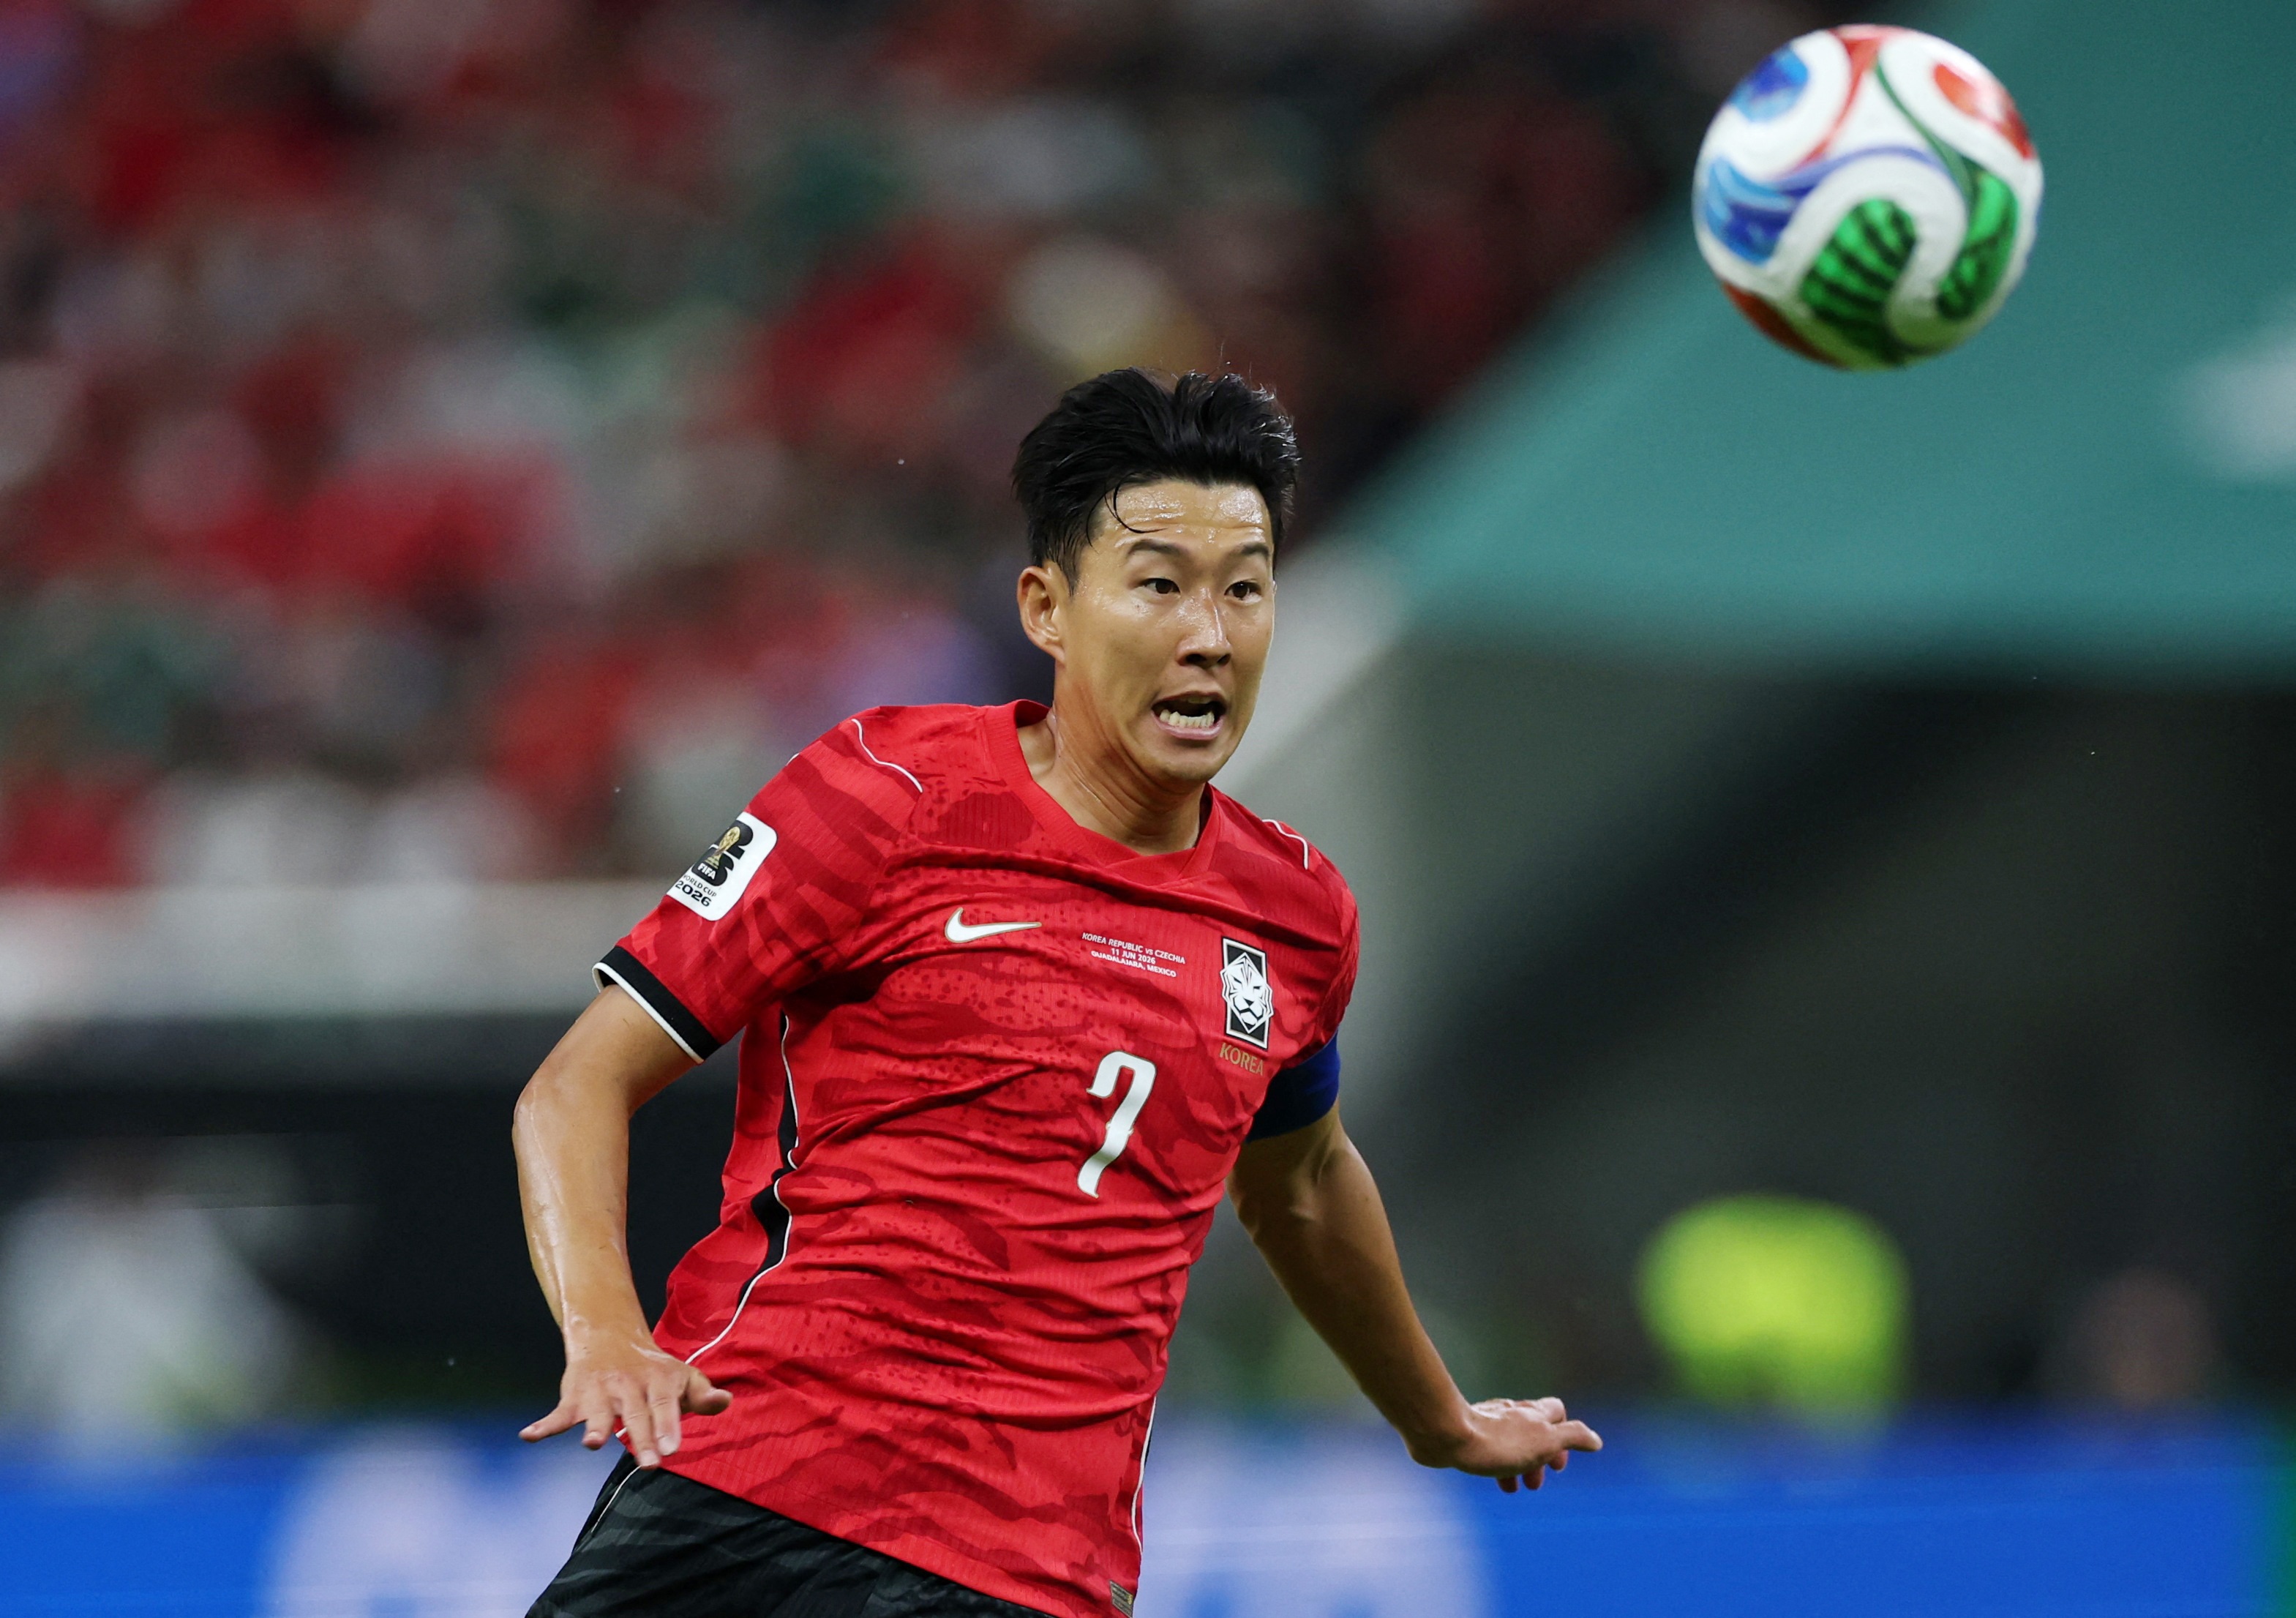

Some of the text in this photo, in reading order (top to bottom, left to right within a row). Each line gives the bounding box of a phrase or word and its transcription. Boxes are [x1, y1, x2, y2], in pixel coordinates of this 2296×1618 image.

[697, 863, 716, 880] FIFA
[675, 880, 712, 907] 2026
[703, 886, 717, 897] CUP
[1082, 932, 1106, 944] KOREA
[1108, 938, 1144, 953] REPUBLIC
[1155, 949, 1185, 964] CZECHIA
[1111, 948, 1156, 965] 11 JUN 2026
[1091, 951, 1177, 978] GUADALAJARA, MEXICO
[1220, 1043, 1264, 1076] KOREA
[1078, 1051, 1156, 1198] 7
